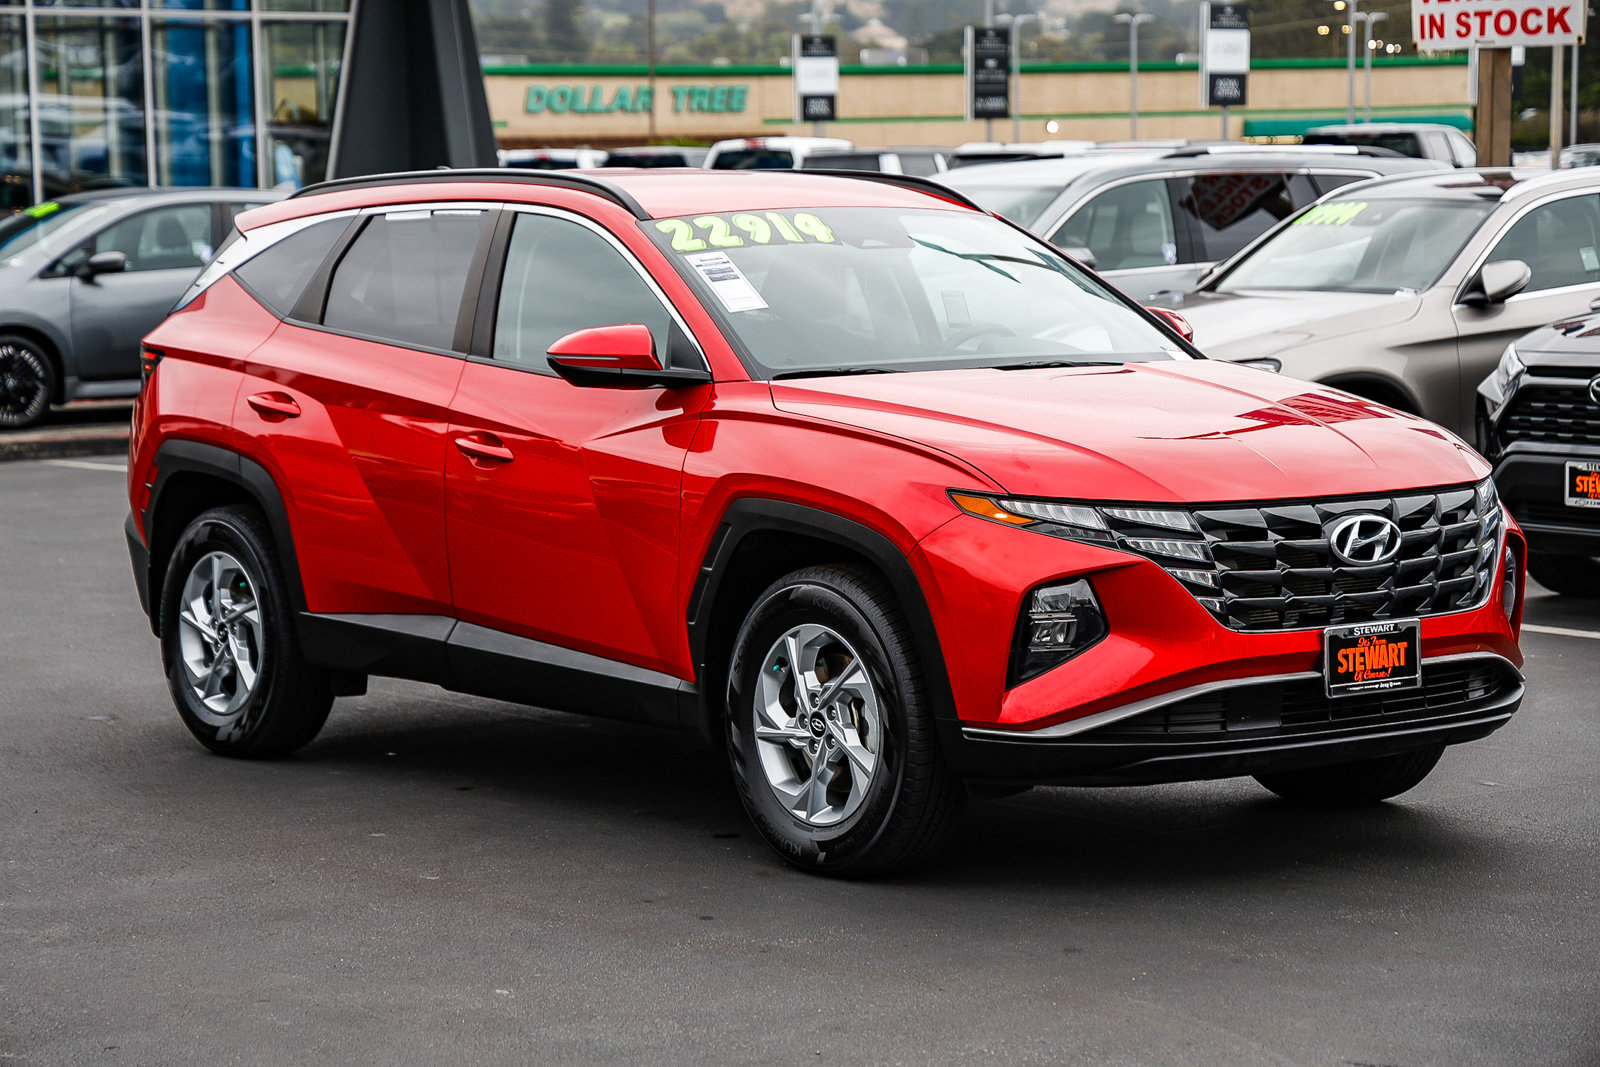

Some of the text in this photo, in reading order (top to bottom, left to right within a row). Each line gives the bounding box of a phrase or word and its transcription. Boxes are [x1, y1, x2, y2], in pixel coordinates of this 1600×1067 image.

[1419, 6, 1572, 39] IN STOCK
[525, 85, 749, 114] DOLLAR TREE
[1354, 624, 1394, 636] STEWART
[1337, 641, 1408, 673] STEWART
